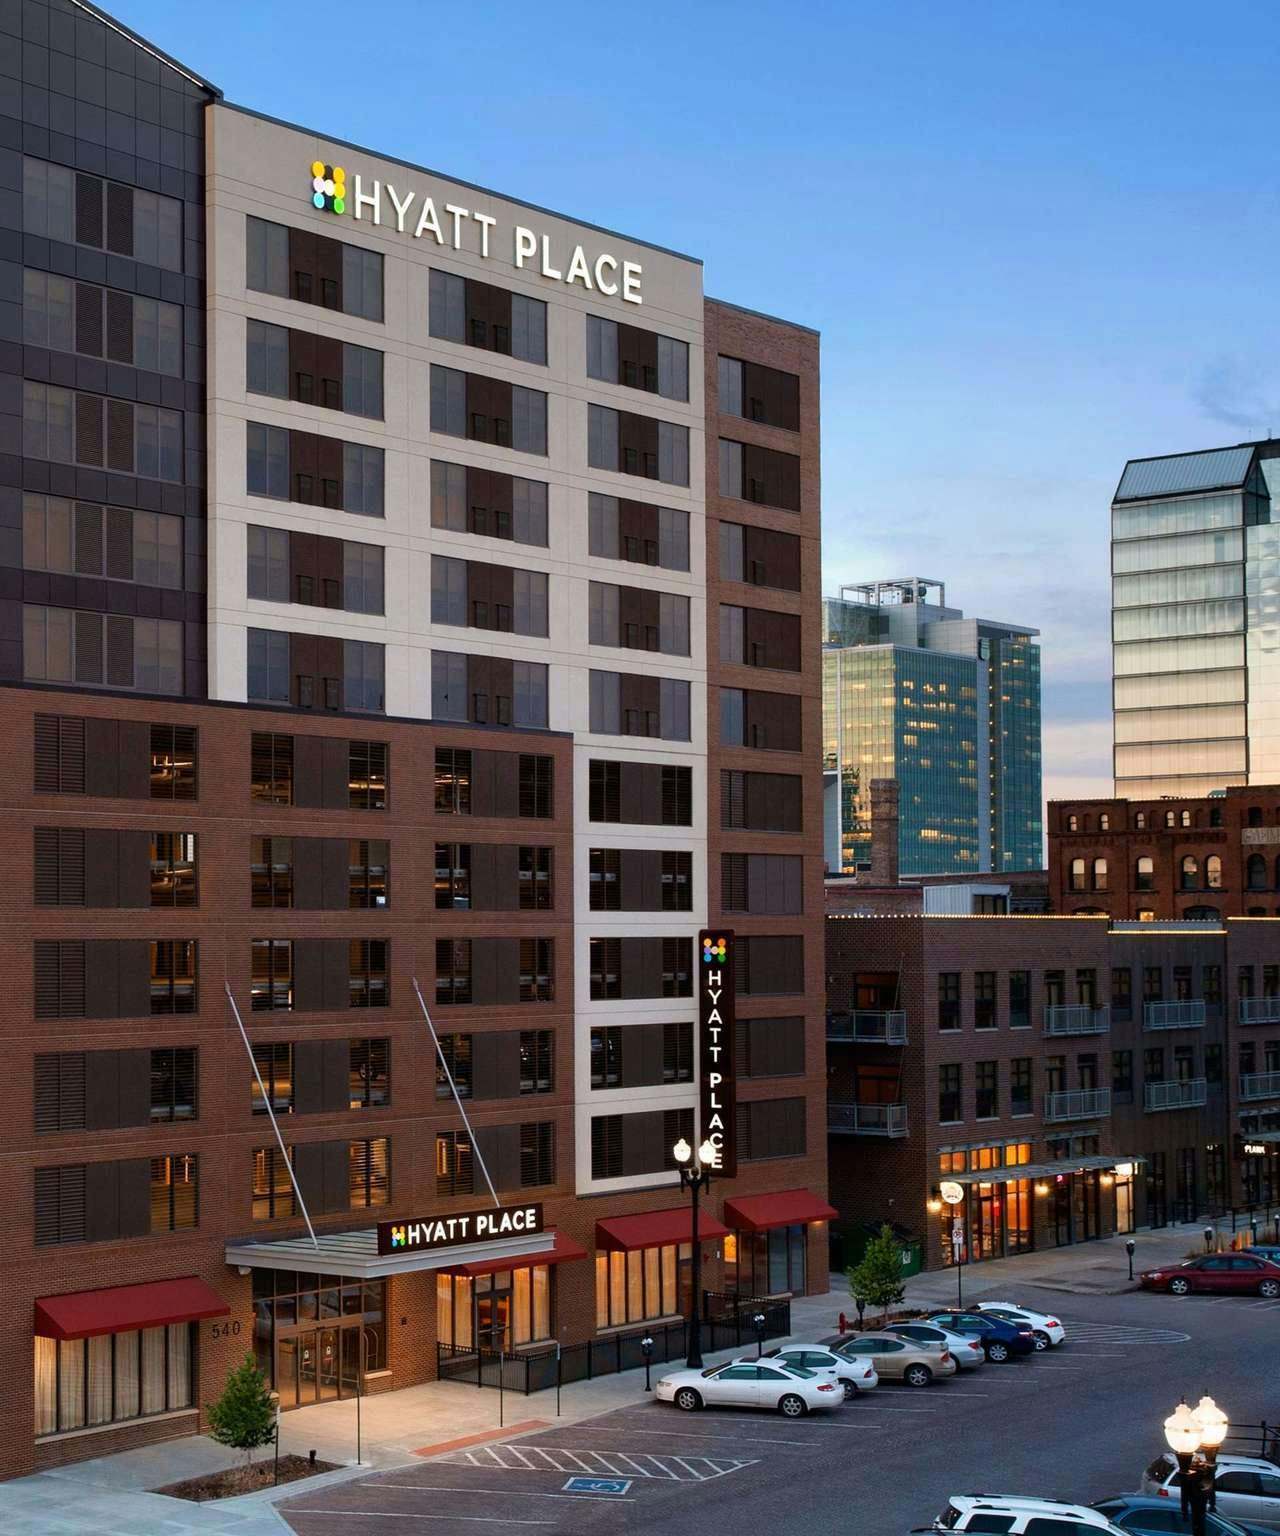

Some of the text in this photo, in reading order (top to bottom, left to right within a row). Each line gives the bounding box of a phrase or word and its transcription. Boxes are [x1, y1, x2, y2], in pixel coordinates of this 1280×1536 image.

[352, 174, 643, 305] HYATT PLACE
[707, 970, 724, 1169] HYATT PLACE
[407, 1208, 537, 1246] HYATT PLACE
[212, 1321, 241, 1339] 540
